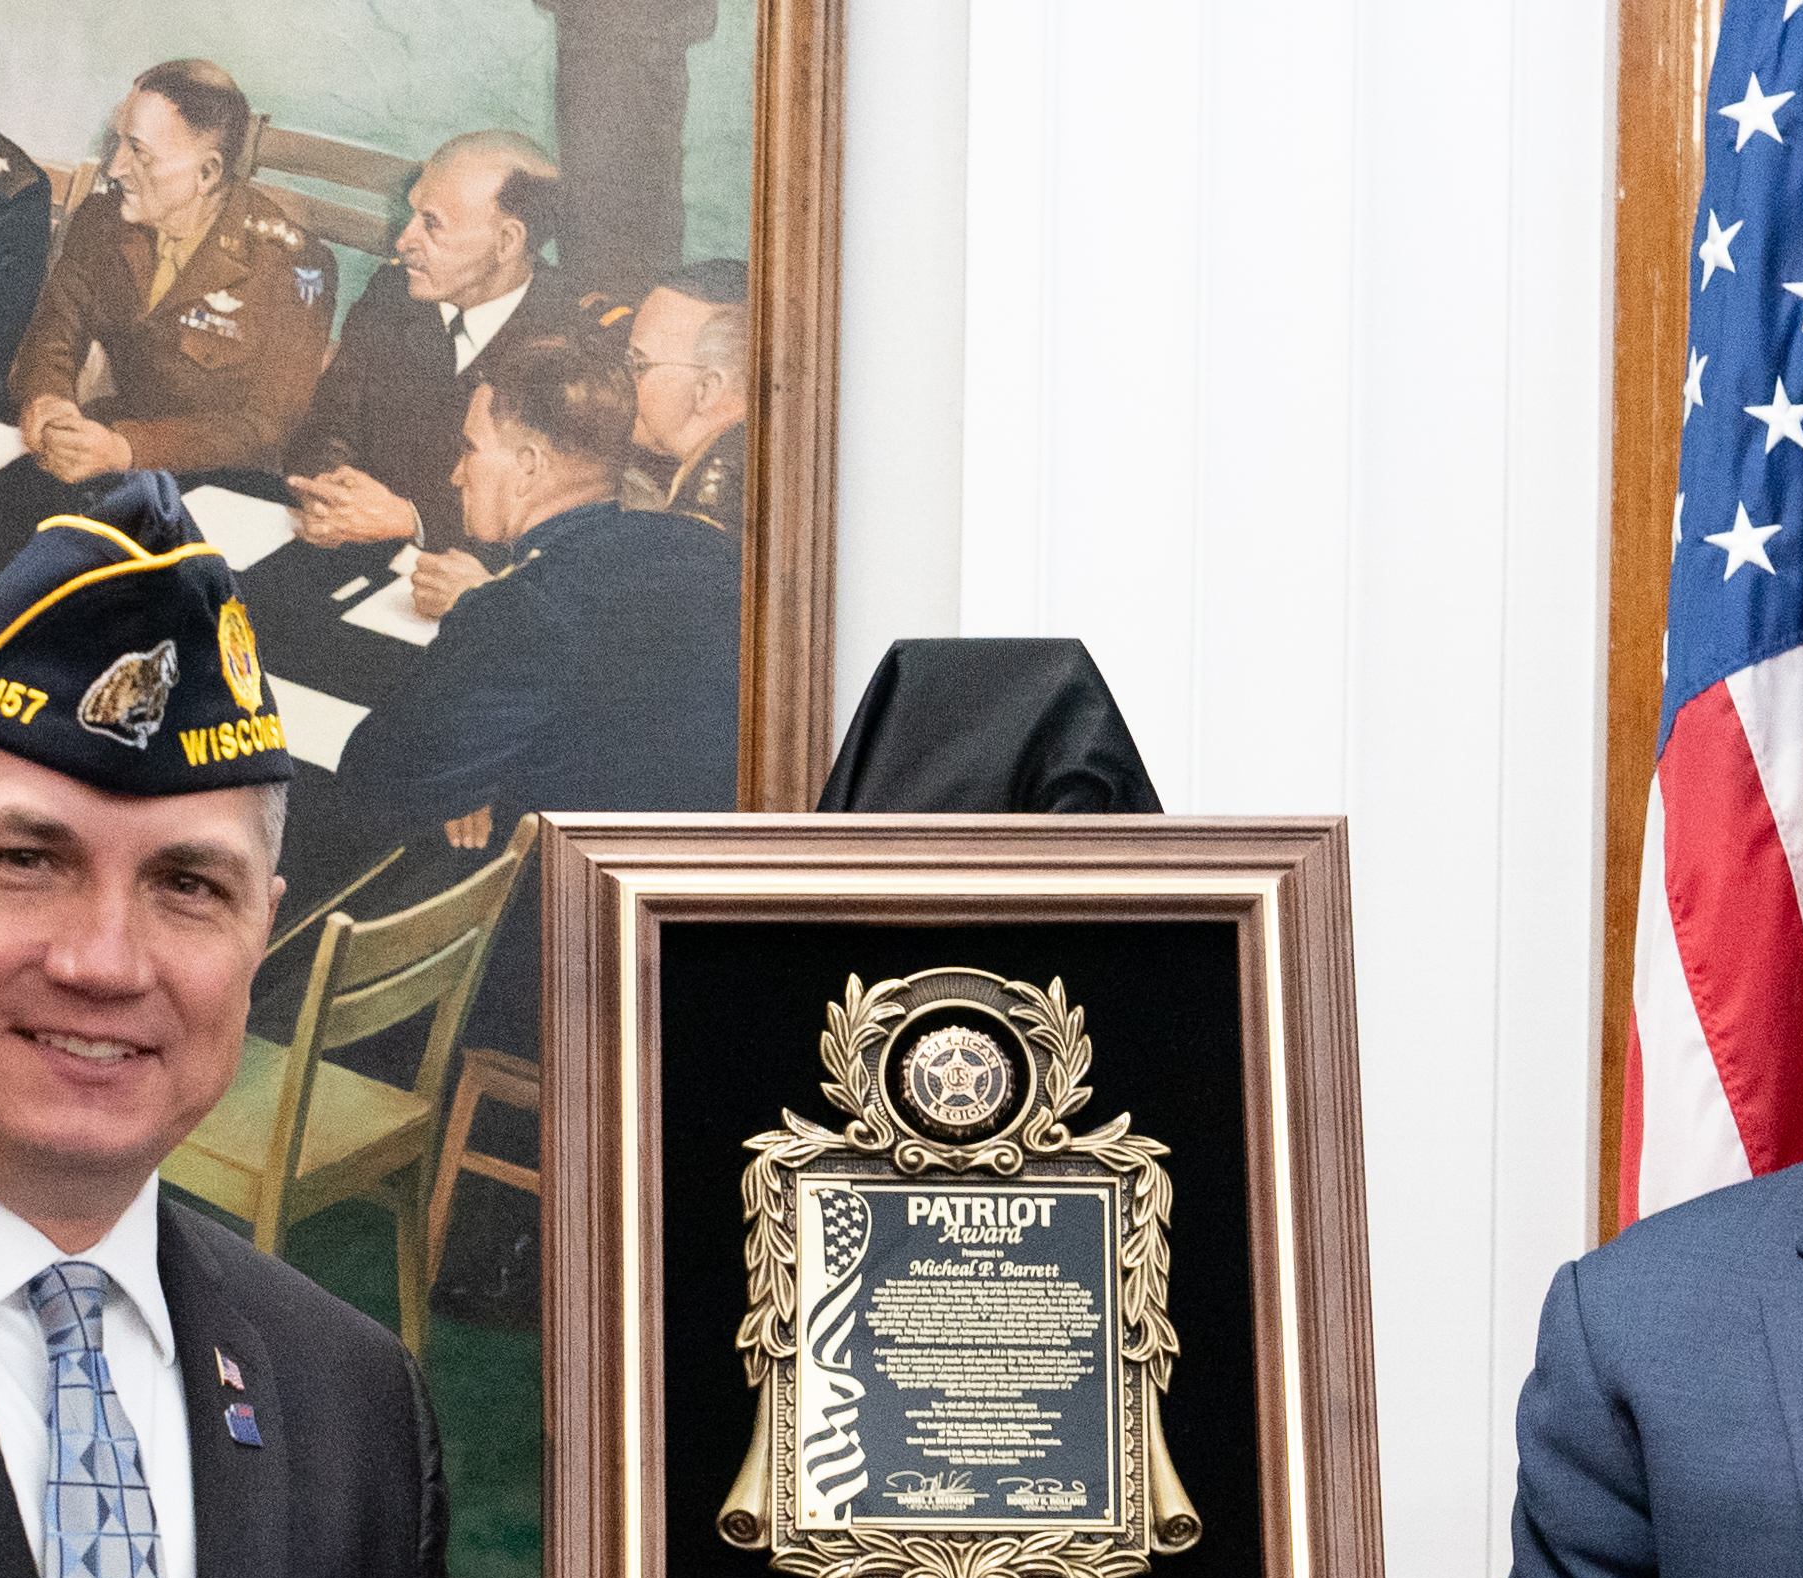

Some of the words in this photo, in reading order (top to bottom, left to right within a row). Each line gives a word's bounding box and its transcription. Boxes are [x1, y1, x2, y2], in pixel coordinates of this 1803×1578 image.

[917, 1036, 999, 1070] AMERICAN
[928, 1100, 991, 1121] LEGION
[908, 1196, 1056, 1227] PATRIOT
[938, 1218, 1023, 1244] Award
[909, 1258, 979, 1277] Micheal
[979, 1261, 995, 1277] P.
[1000, 1261, 1060, 1278] Barrett
